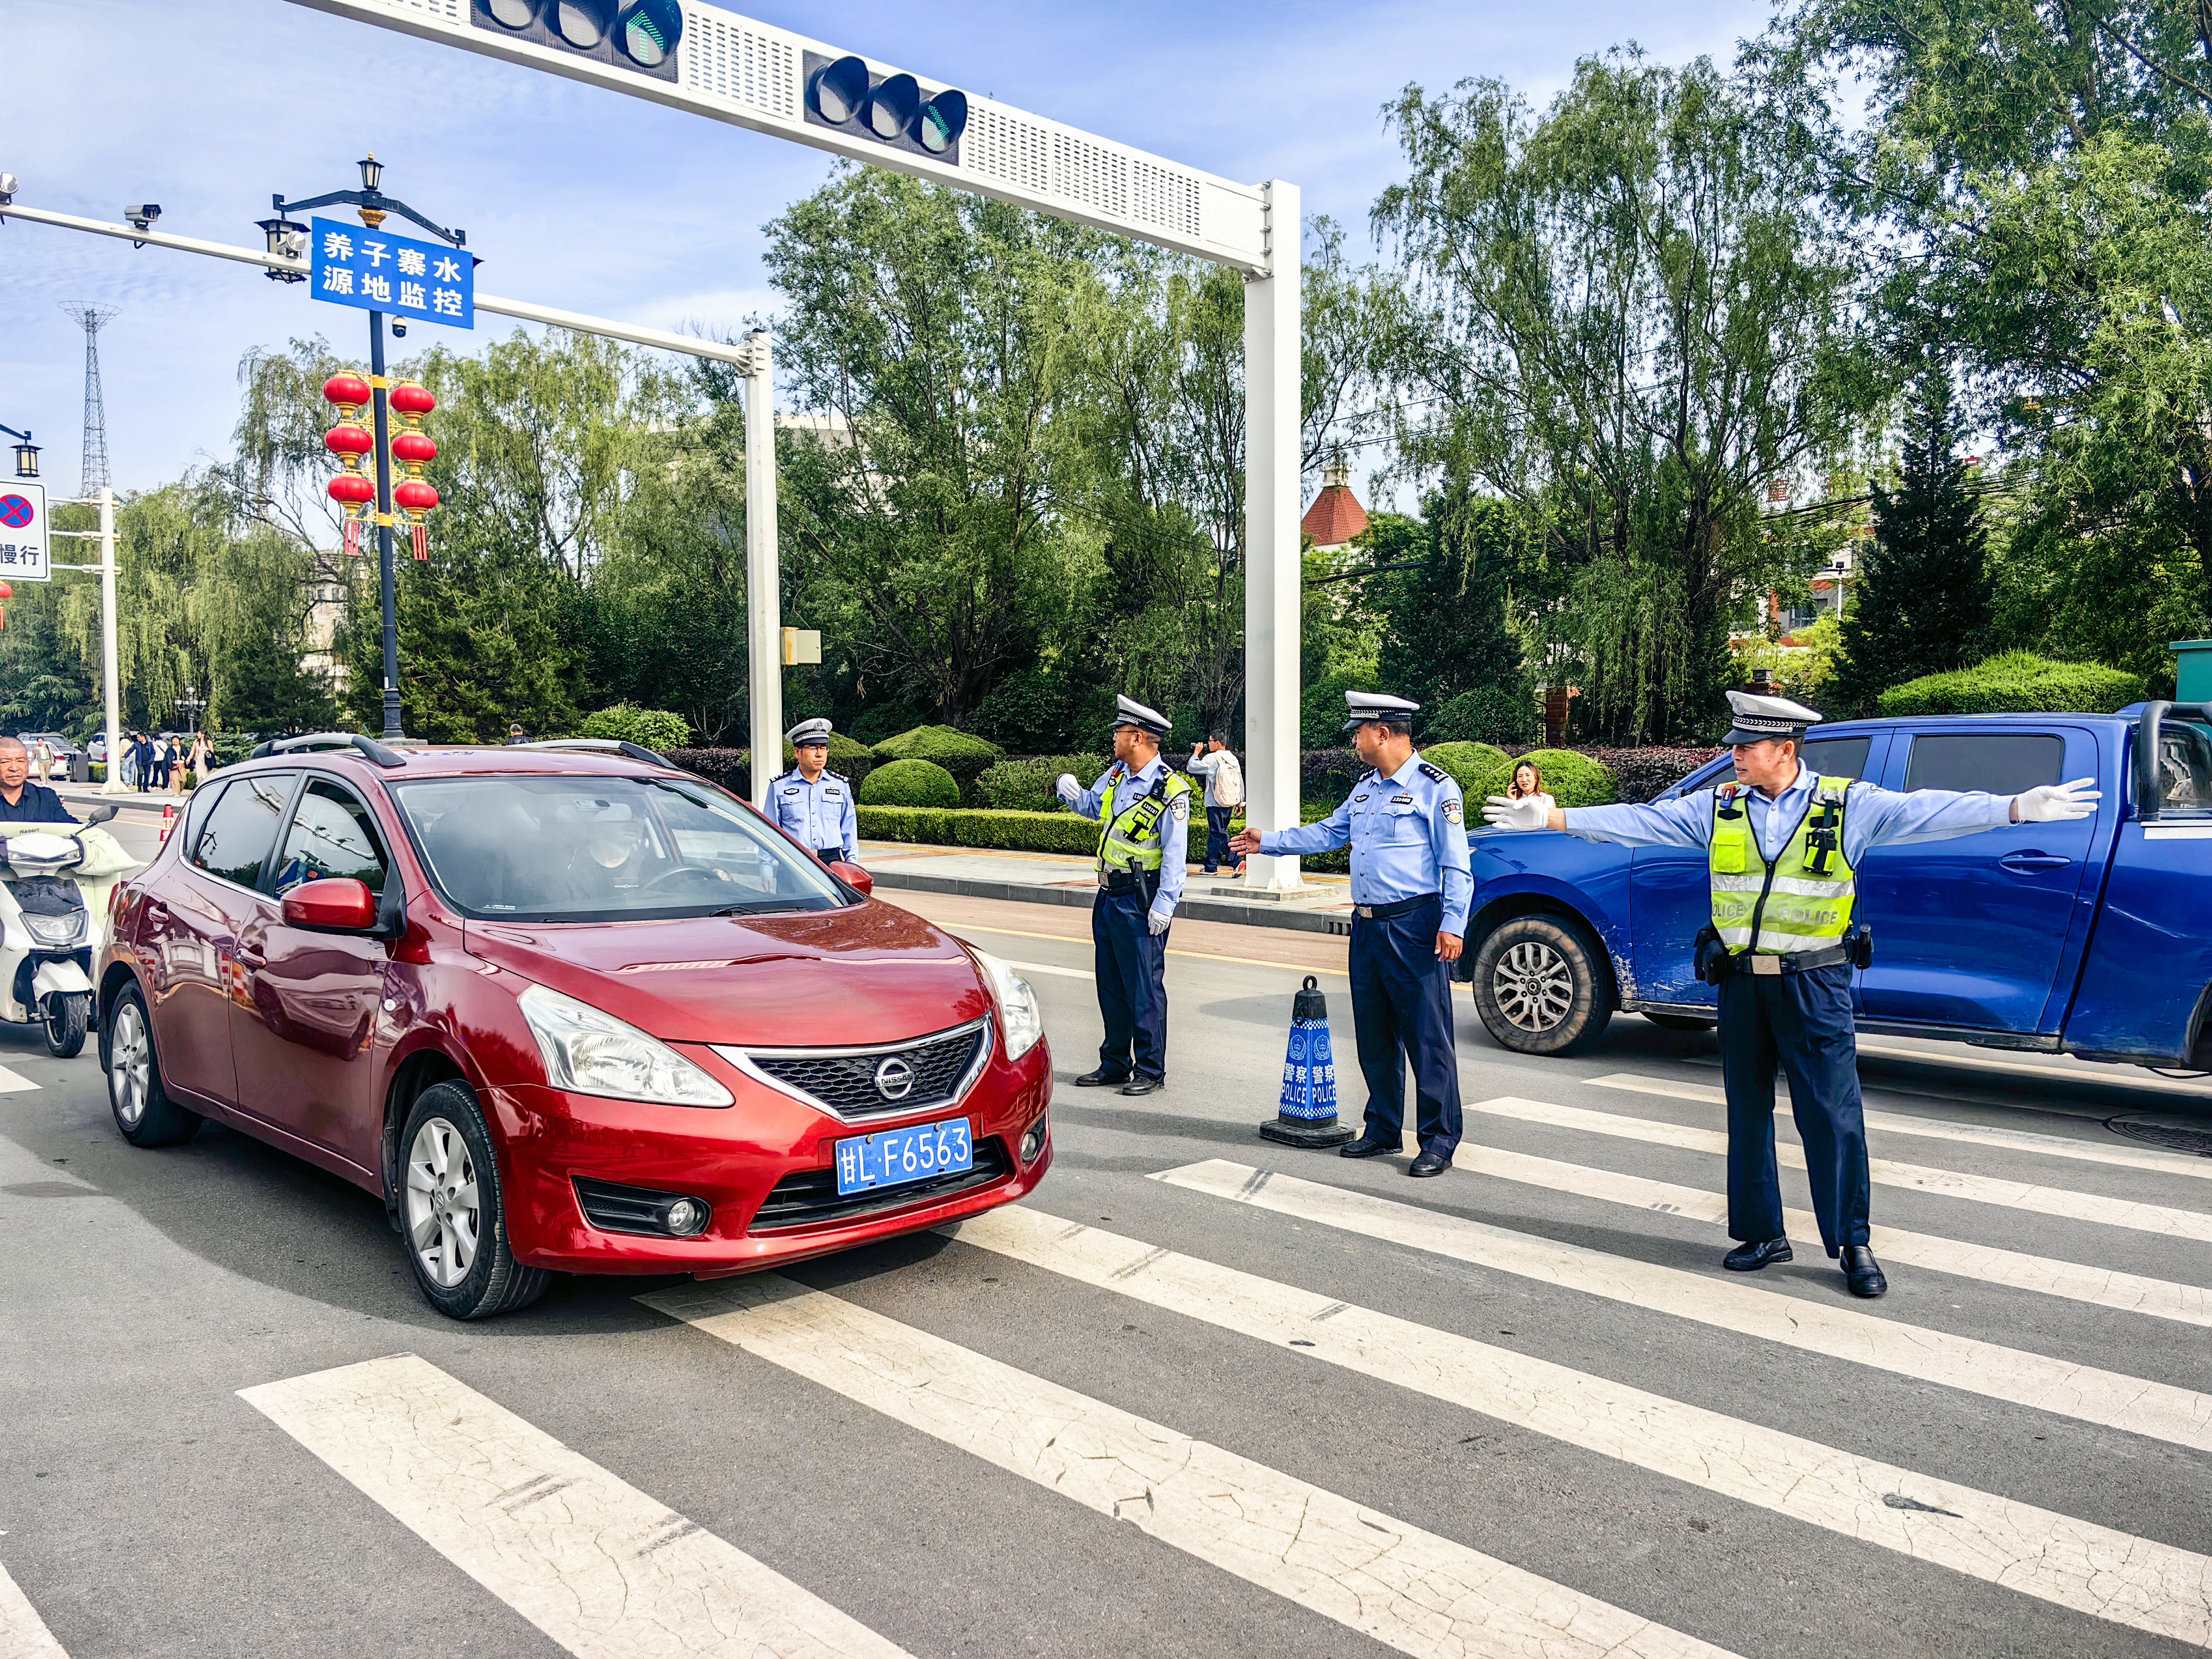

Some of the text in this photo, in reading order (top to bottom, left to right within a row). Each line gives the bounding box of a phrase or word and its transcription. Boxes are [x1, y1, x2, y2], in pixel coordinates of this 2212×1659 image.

[324, 232, 462, 282] 养子寨水
[323, 265, 463, 317] 源地监控
[1712, 903, 1744, 917] OLICE
[1779, 905, 1838, 925] POLICE
[881, 1073, 914, 1084] NISSAN
[1285, 1062, 1307, 1084] 警察
[1312, 1064, 1334, 1084] 警察
[1281, 1082, 1307, 1104] POLICE
[1312, 1084, 1337, 1104] POLICE
